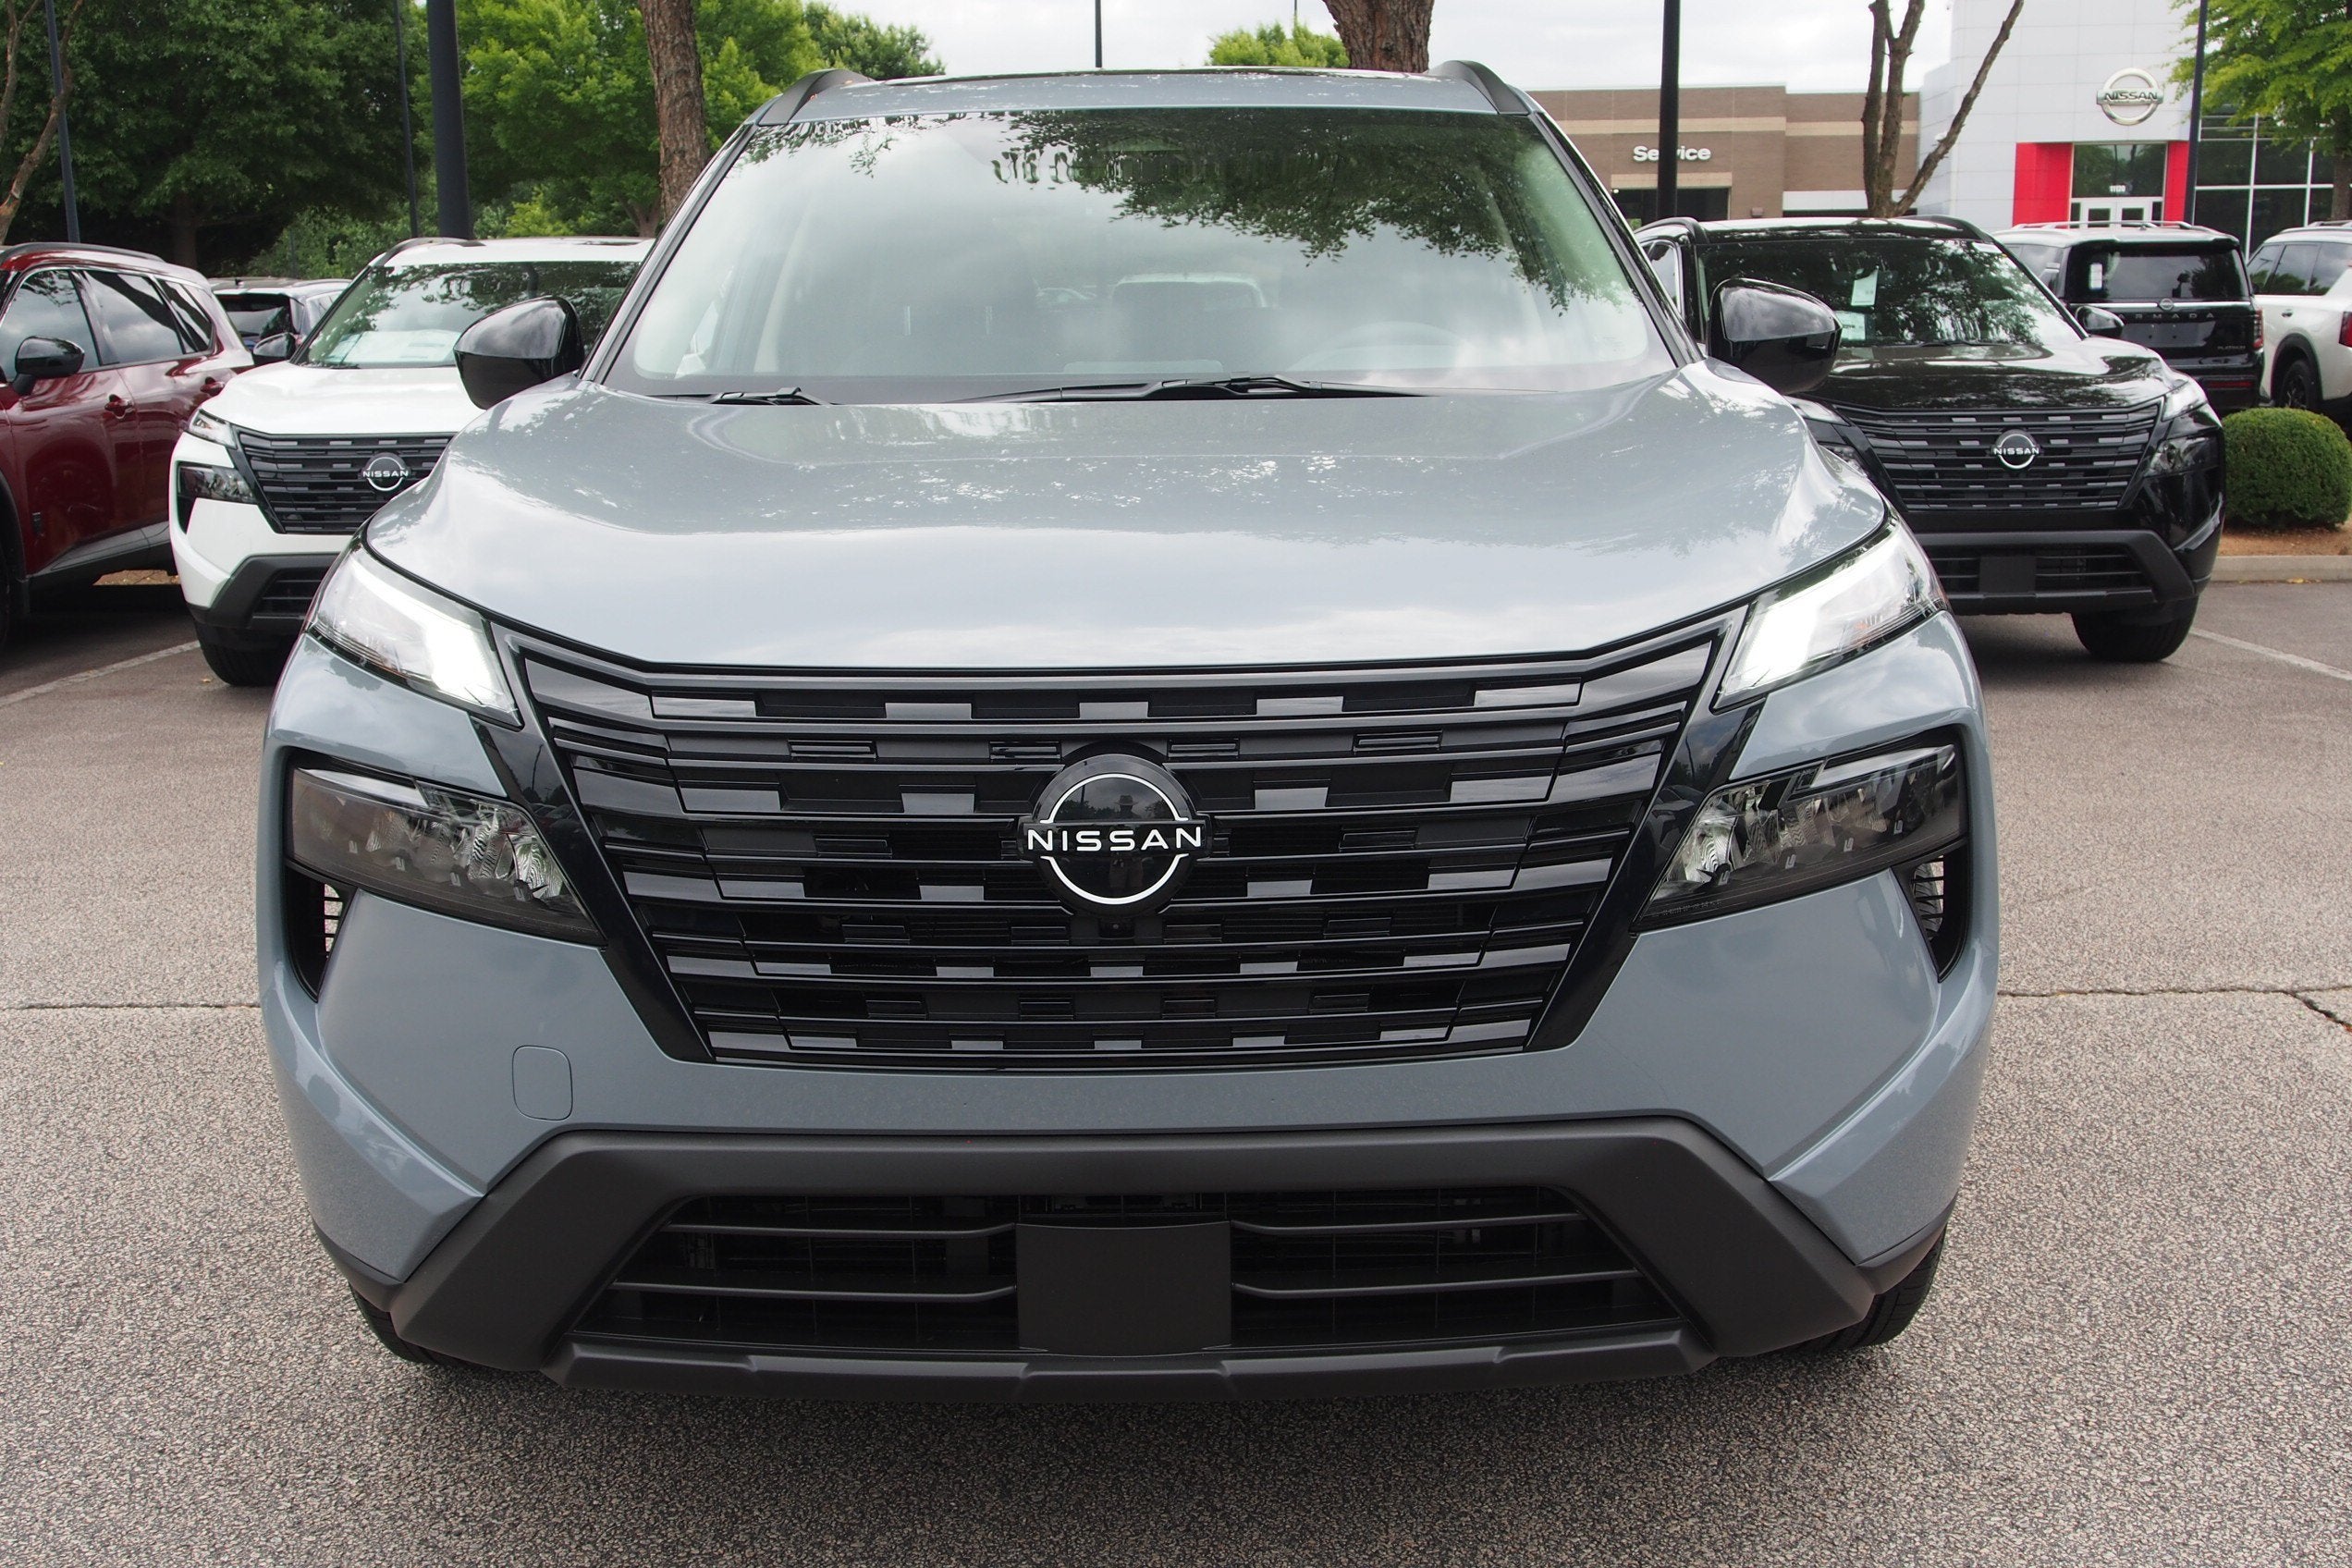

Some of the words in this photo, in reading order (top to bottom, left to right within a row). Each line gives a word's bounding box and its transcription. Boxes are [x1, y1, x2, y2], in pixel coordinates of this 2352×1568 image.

[2104, 92, 2157, 100] NISSAN
[1633, 145, 1711, 161] Seice
[1027, 827, 1201, 851] NISSAN
